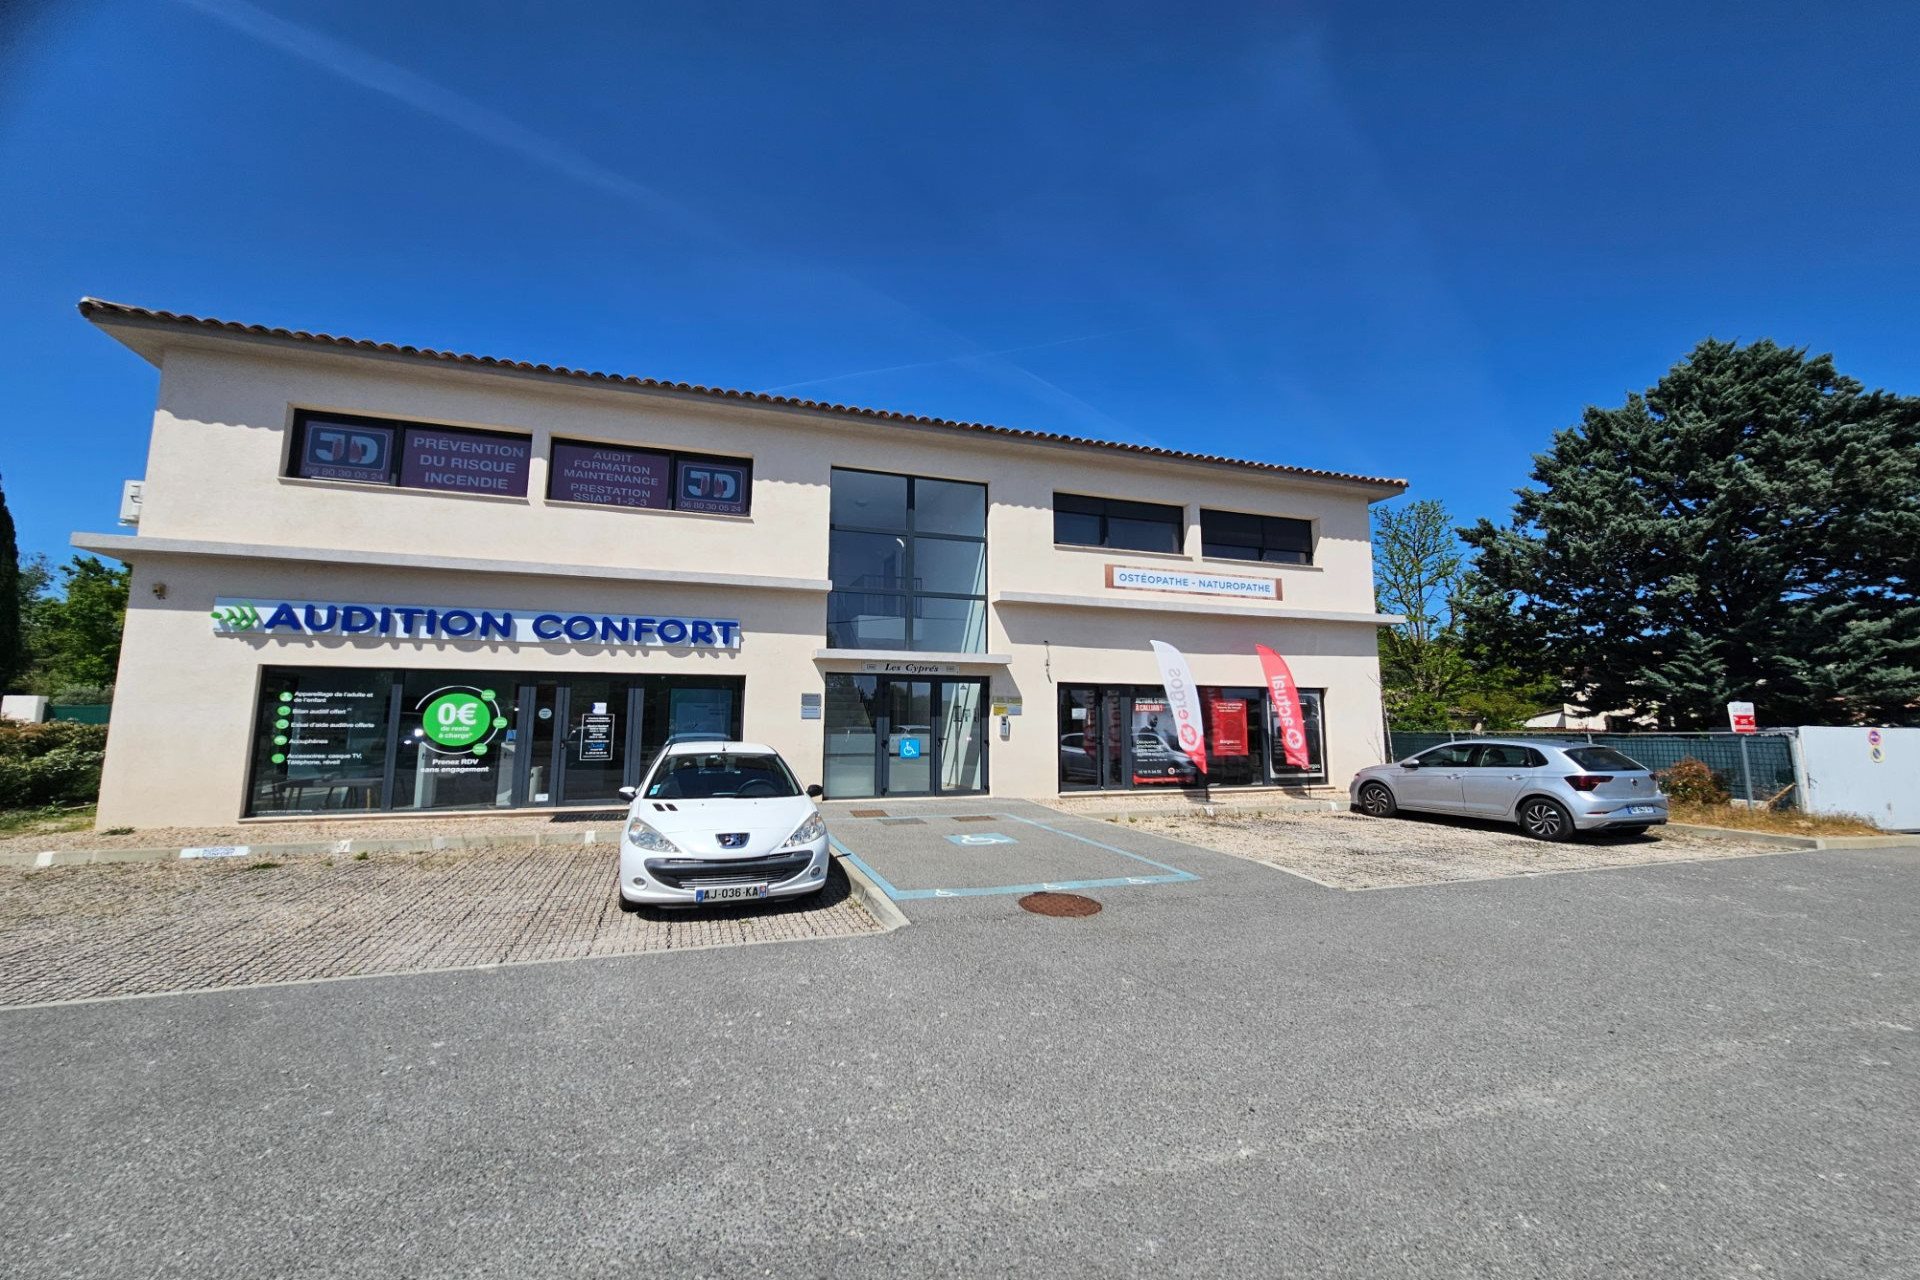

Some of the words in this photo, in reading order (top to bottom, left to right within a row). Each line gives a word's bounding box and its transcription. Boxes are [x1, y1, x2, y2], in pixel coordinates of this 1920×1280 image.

[413, 437, 524, 458] PRÉVENTION
[420, 455, 445, 467] DU
[450, 457, 517, 474] RISQUE
[593, 452, 633, 463] AUDIT
[574, 460, 650, 475] FORMATION
[424, 472, 509, 490] INCENDIE
[563, 469, 659, 486] MAINTENANCE
[570, 483, 651, 498] PRESTATION
[573, 493, 613, 503] SSIAP
[617, 498, 648, 507] 1-2-3
[1119, 572, 1189, 587] OSTÉOPATHE
[1199, 579, 1271, 593] NATUROPATHE
[264, 603, 512, 638] AUDITION
[532, 614, 739, 645] CONFORT
[884, 663, 900, 672] Les
[437, 703, 478, 725] 0€
[440, 766, 490, 774] engagement
[704, 885, 759, 900] AJ-036-KA
